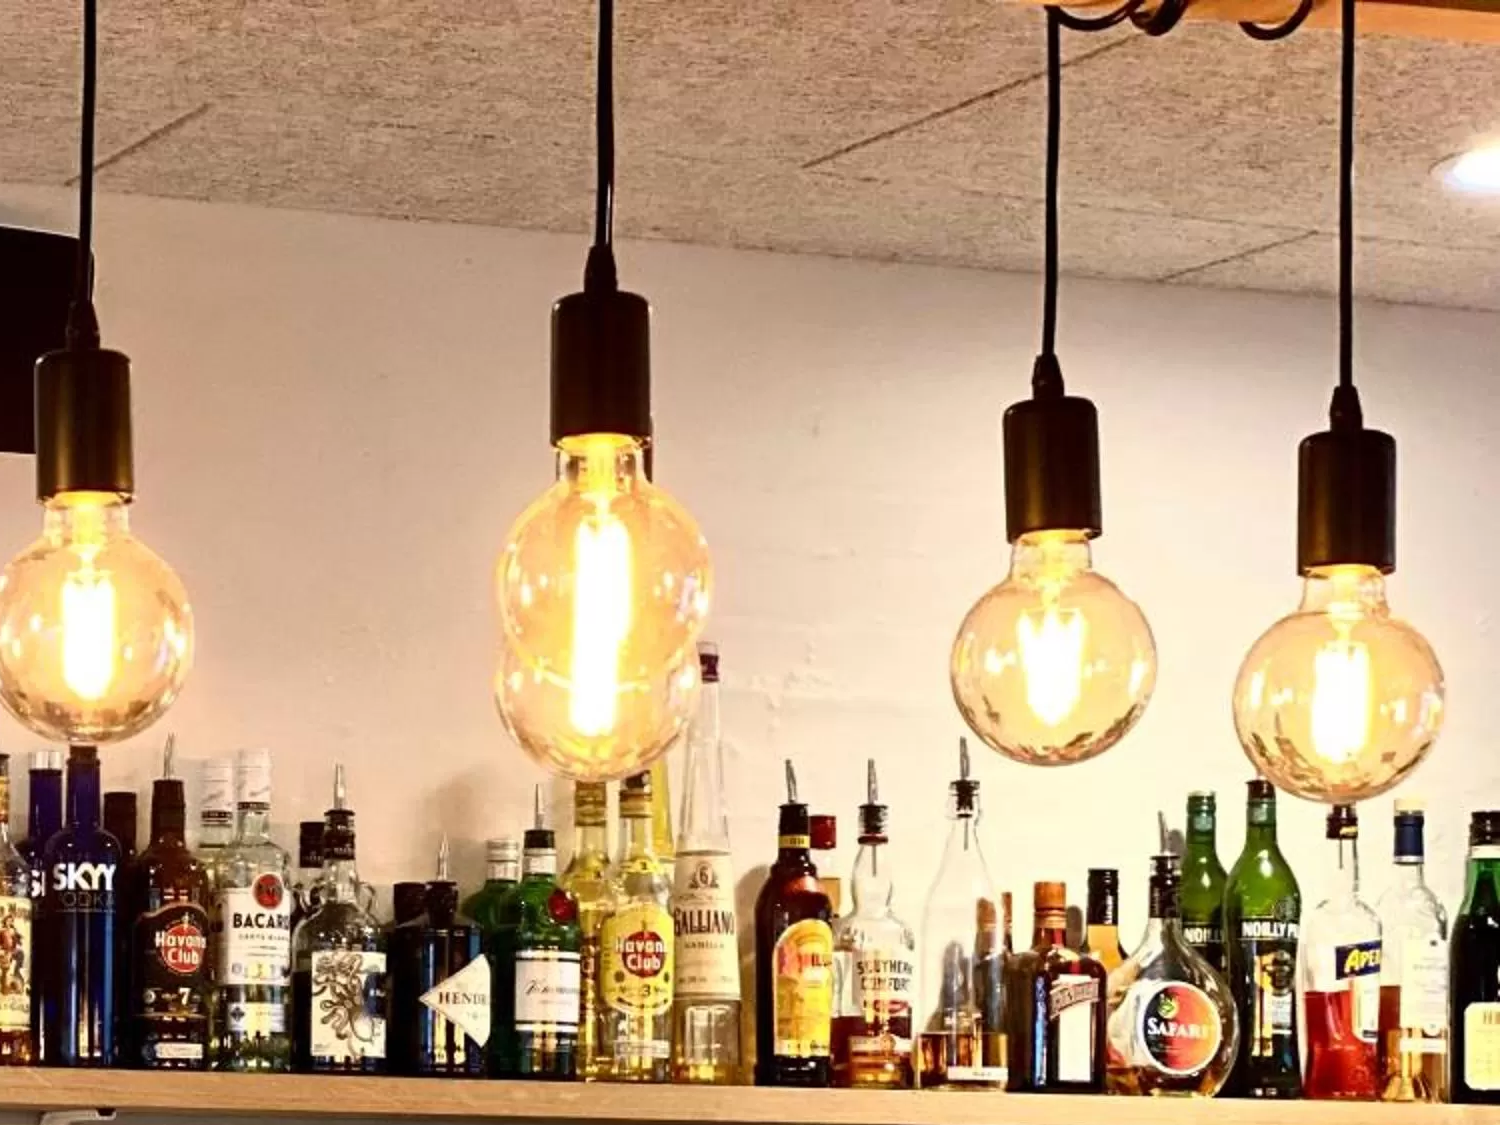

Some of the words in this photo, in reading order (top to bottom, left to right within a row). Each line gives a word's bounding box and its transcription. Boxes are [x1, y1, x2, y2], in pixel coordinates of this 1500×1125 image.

[53, 862, 117, 891] SKYY
[674, 907, 735, 936] GALLIANO
[1241, 920, 1287, 938] NOILLY
[616, 937, 665, 953] Havan
[168, 947, 199, 965] Club
[626, 952, 661, 970] Club
[178, 987, 191, 1005] 7
